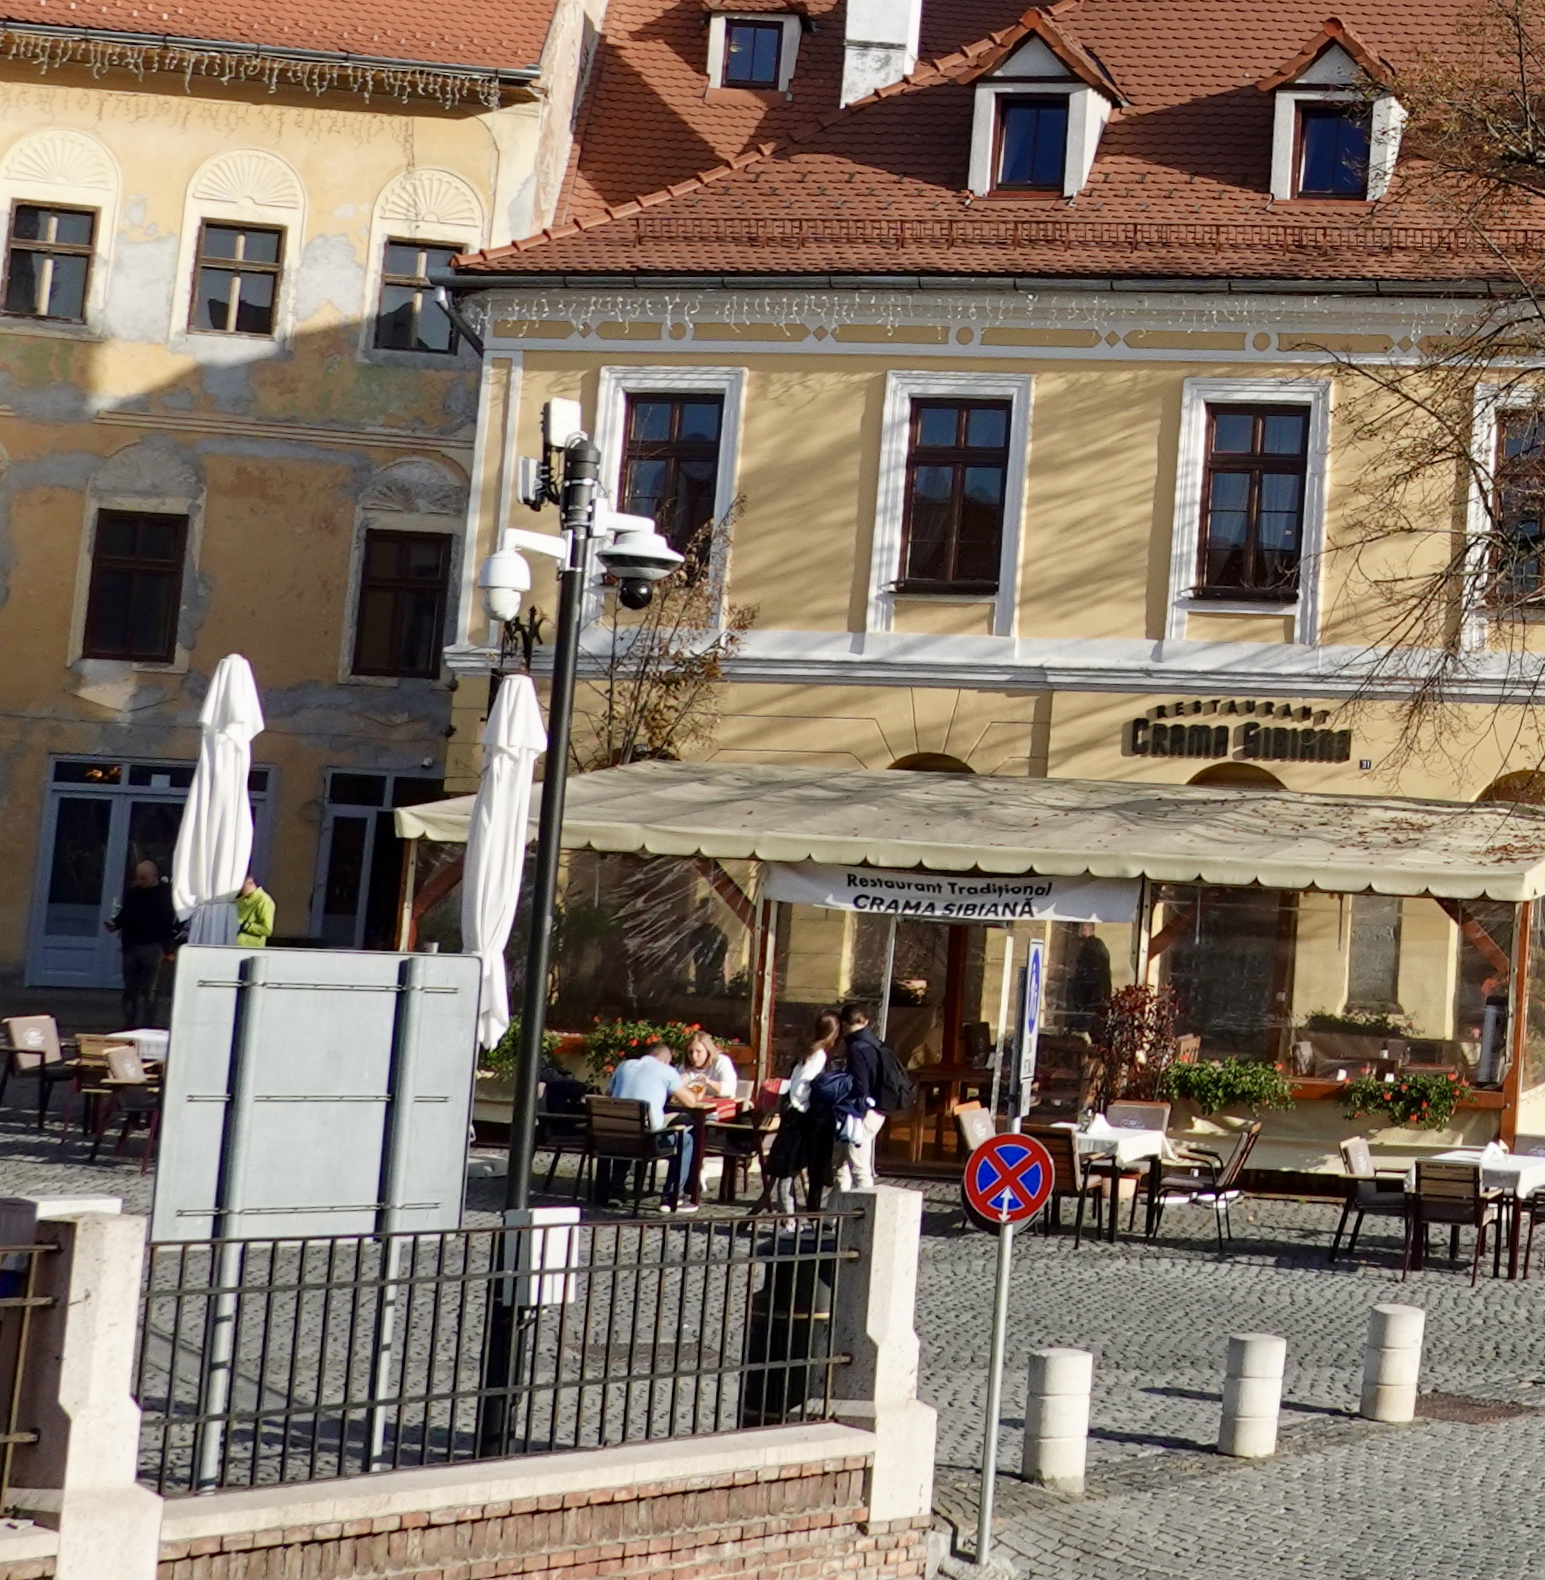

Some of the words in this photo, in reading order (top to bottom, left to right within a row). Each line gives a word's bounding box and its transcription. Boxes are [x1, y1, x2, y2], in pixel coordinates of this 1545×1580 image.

[1156, 699, 1330, 726] RESTAURANT
[847, 873, 943, 895] Restaurant
[853, 894, 936, 915] CRAMA
[942, 897, 1036, 918] SIBIANĂ
